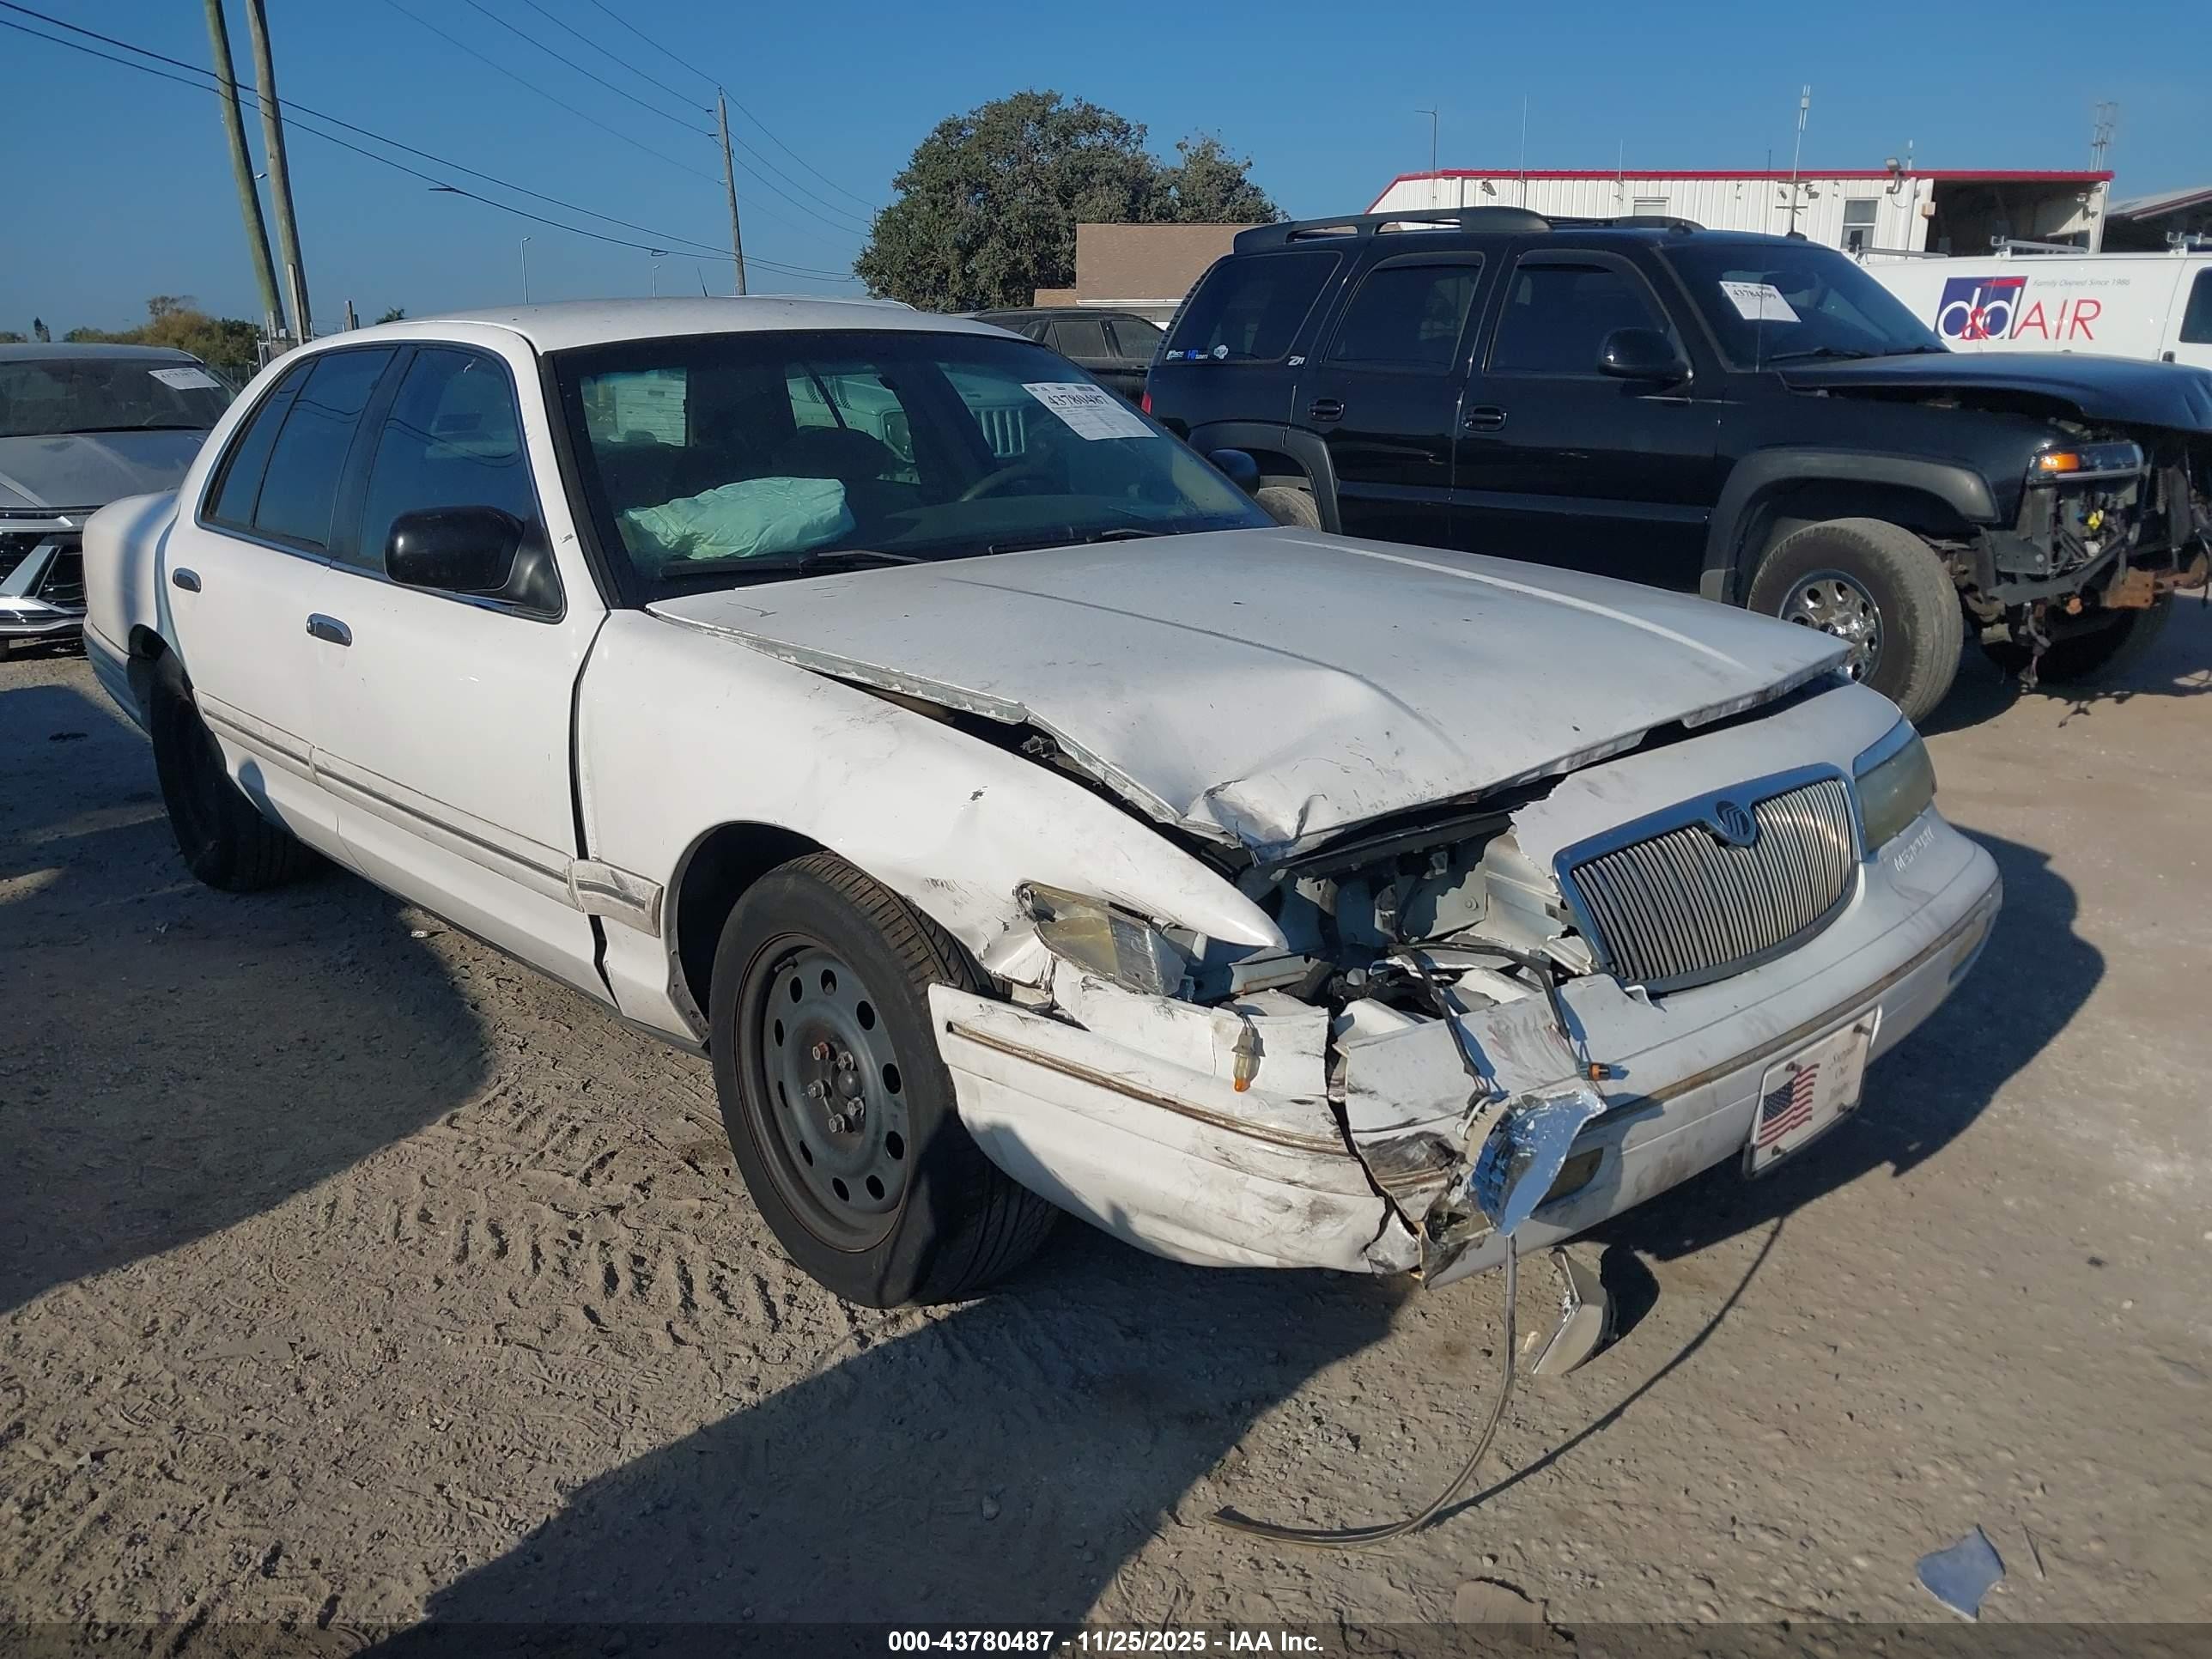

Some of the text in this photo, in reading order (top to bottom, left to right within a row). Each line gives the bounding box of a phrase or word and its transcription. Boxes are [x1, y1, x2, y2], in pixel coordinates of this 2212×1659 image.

[2088, 278, 2109, 287] Since
[2013, 298, 2102, 340] AIR
[1047, 394, 1109, 406] 43780487
